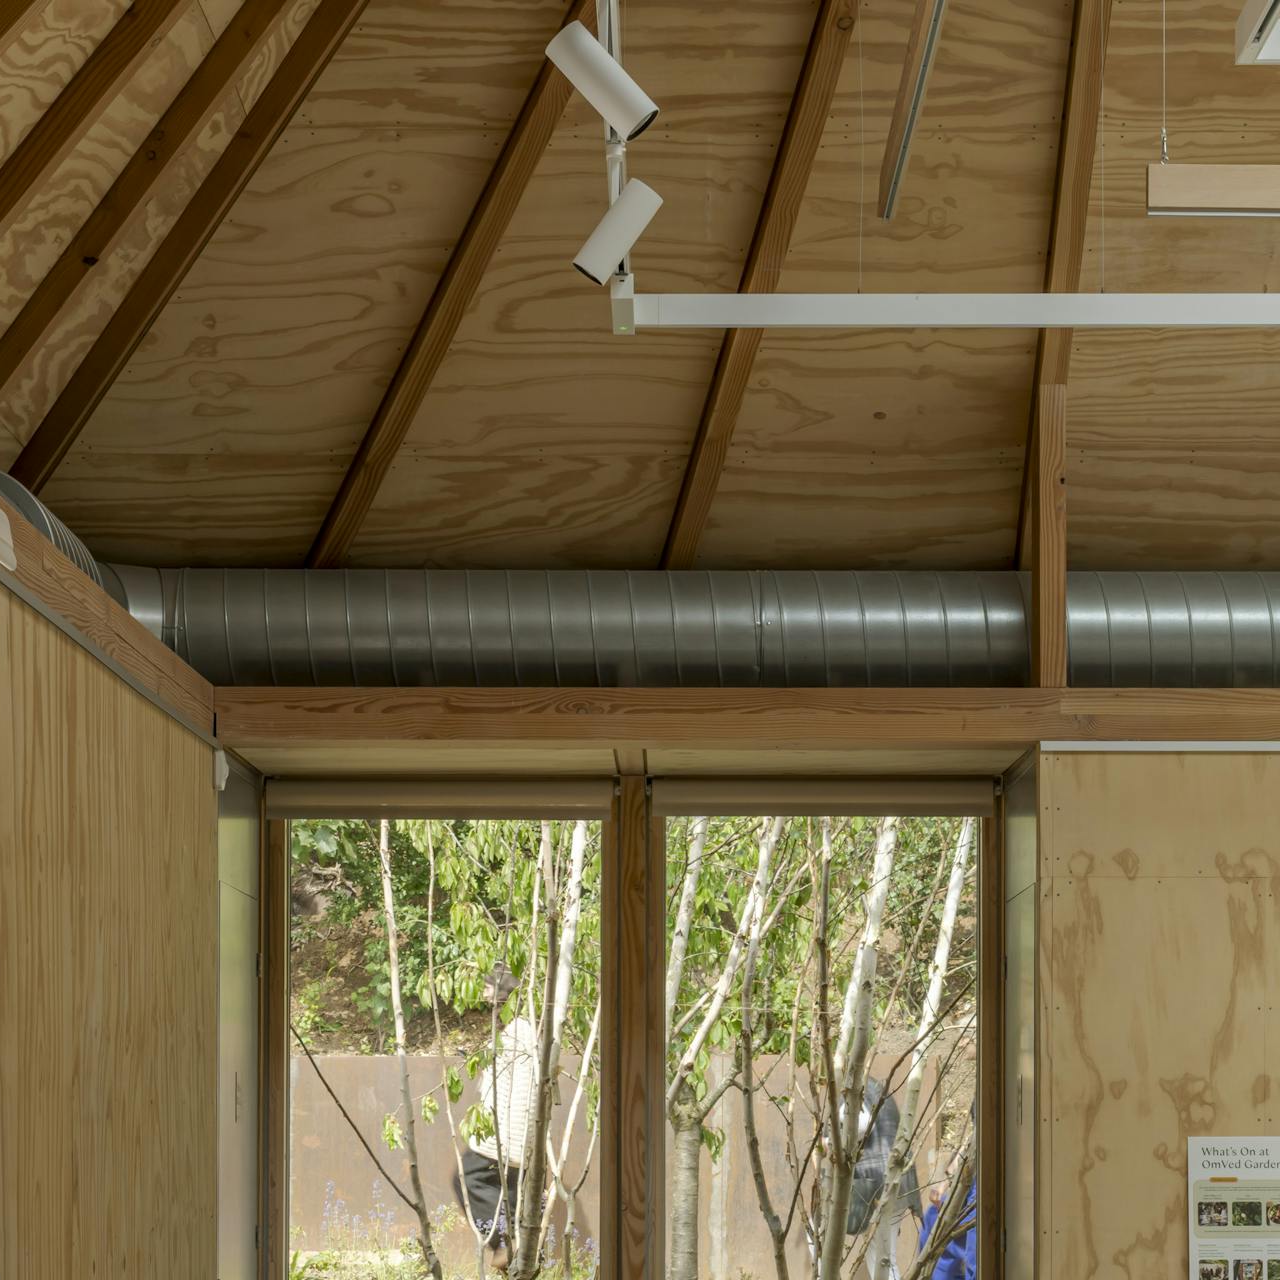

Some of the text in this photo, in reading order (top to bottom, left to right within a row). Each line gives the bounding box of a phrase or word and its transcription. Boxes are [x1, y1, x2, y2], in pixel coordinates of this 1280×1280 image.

[1201, 1146, 1269, 1157] What's On at
[1201, 1159, 1241, 1169] OmVed
